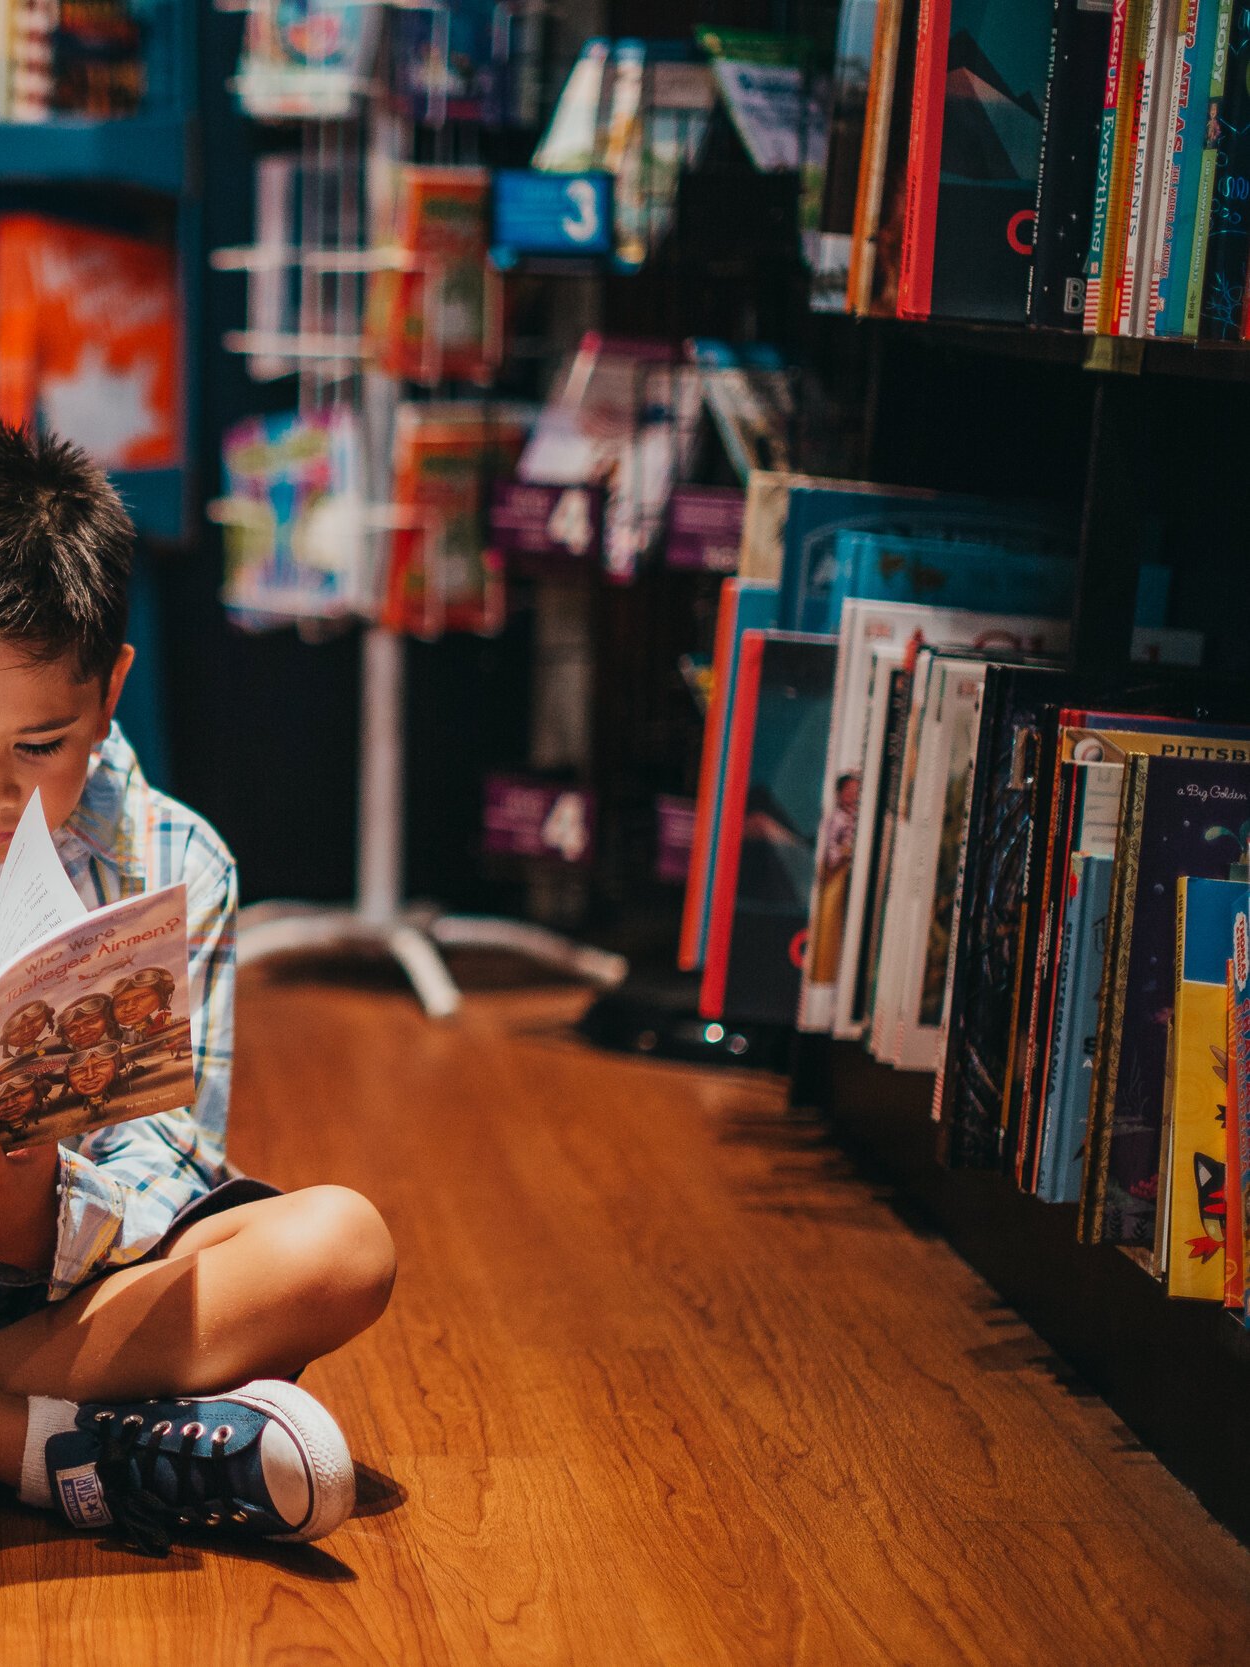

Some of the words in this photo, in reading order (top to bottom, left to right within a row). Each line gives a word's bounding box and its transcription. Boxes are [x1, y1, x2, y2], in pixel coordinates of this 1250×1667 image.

[1211, 13, 1229, 83] BODY
[1174, 61, 1192, 152] ATLAS
[563, 180, 597, 242] 3
[1092, 115, 1115, 252] Everything
[1129, 121, 1147, 237] ELEMENTS
[1166, 186, 1179, 224] WORLD
[547, 488, 592, 556] 4
[1161, 743, 1250, 762] PITTSB
[1186, 784, 1208, 802] Big
[1210, 785, 1248, 800] Golden
[542, 792, 589, 863] 4
[5, 953, 91, 1003] Tuskegee
[97, 917, 181, 959] Airmen?
[25, 951, 63, 975] Who
[68, 928, 116, 952] Were
[76, 1476, 97, 1502] STAR
